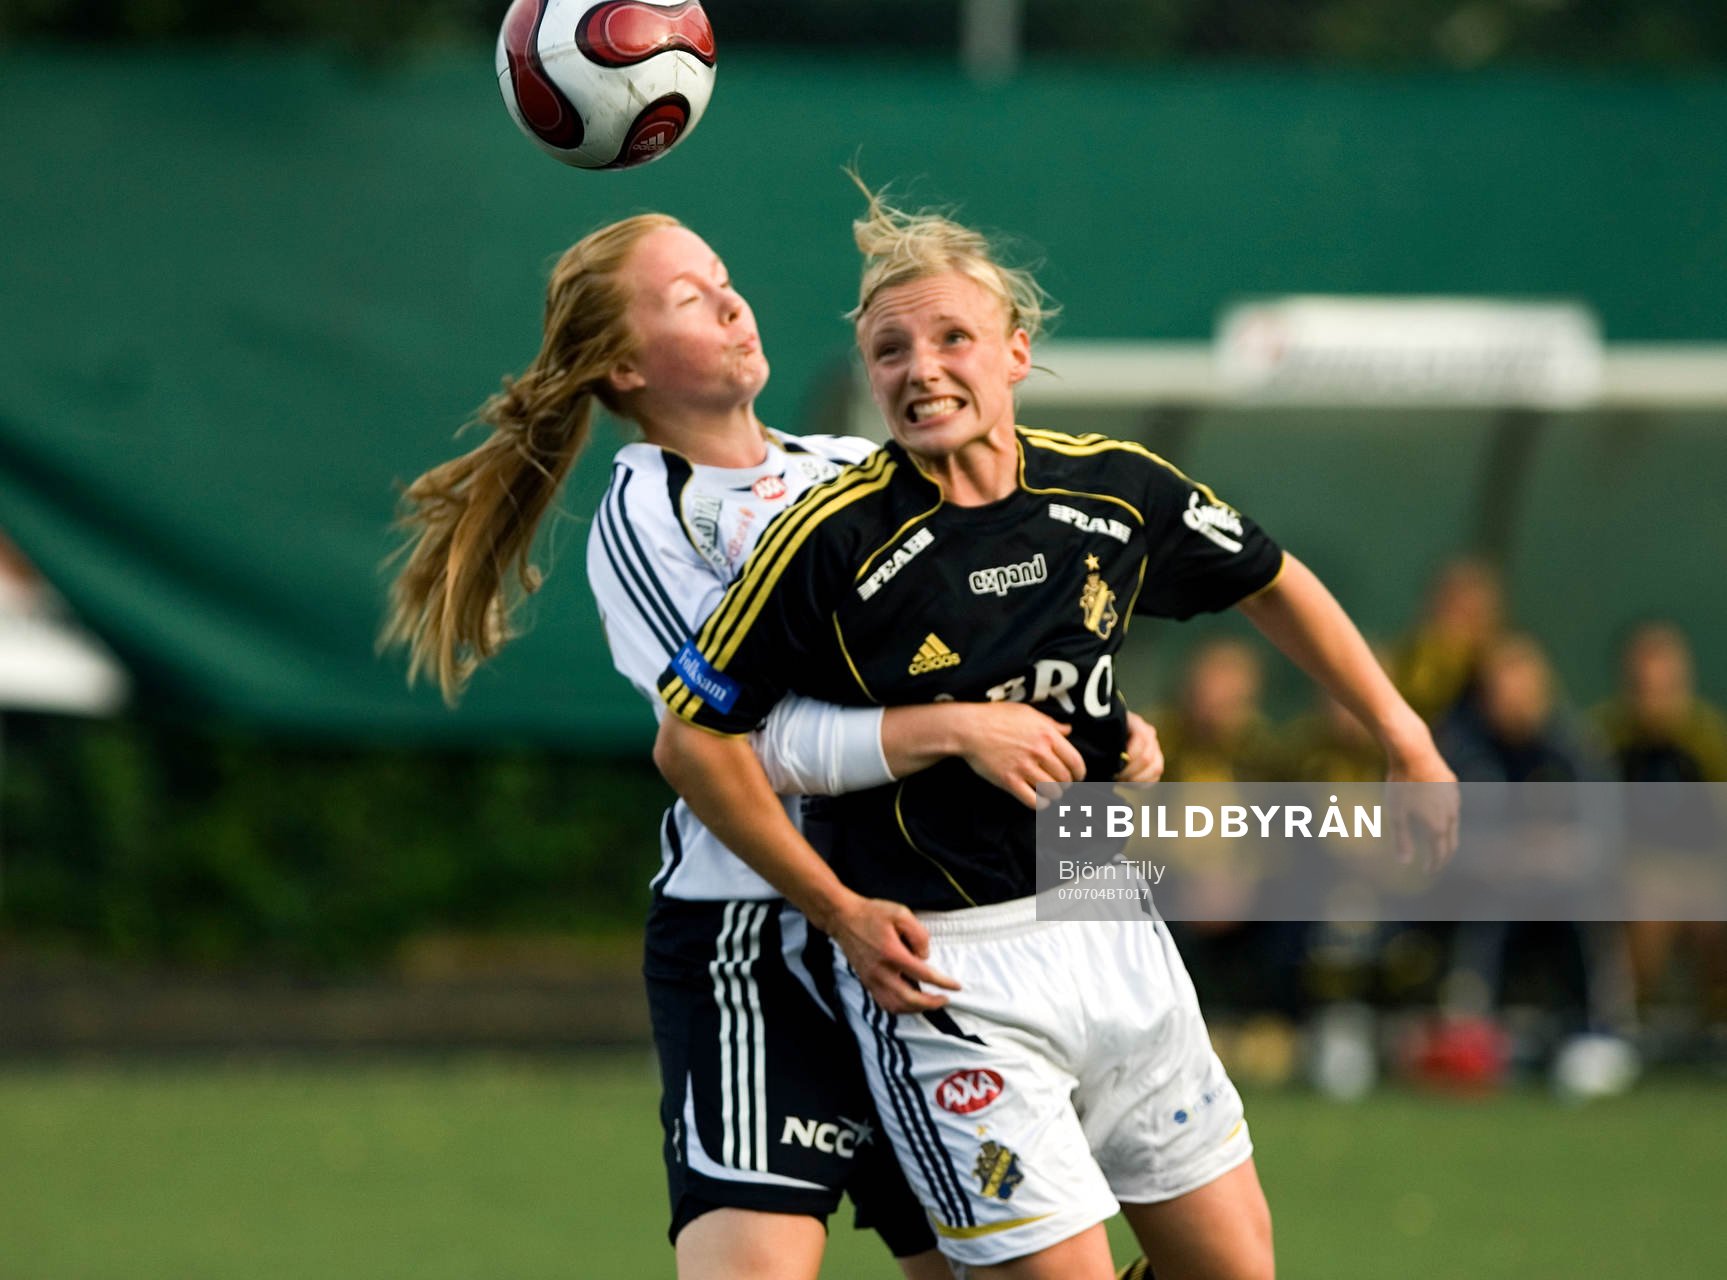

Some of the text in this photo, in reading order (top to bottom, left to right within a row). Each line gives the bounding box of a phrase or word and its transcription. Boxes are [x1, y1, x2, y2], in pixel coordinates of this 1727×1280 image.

[970, 554, 1047, 596] expand
[678, 648, 727, 701] Folksam
[908, 652, 961, 676] adidas
[943, 1071, 999, 1109] AXA
[780, 1116, 855, 1158] NCC
